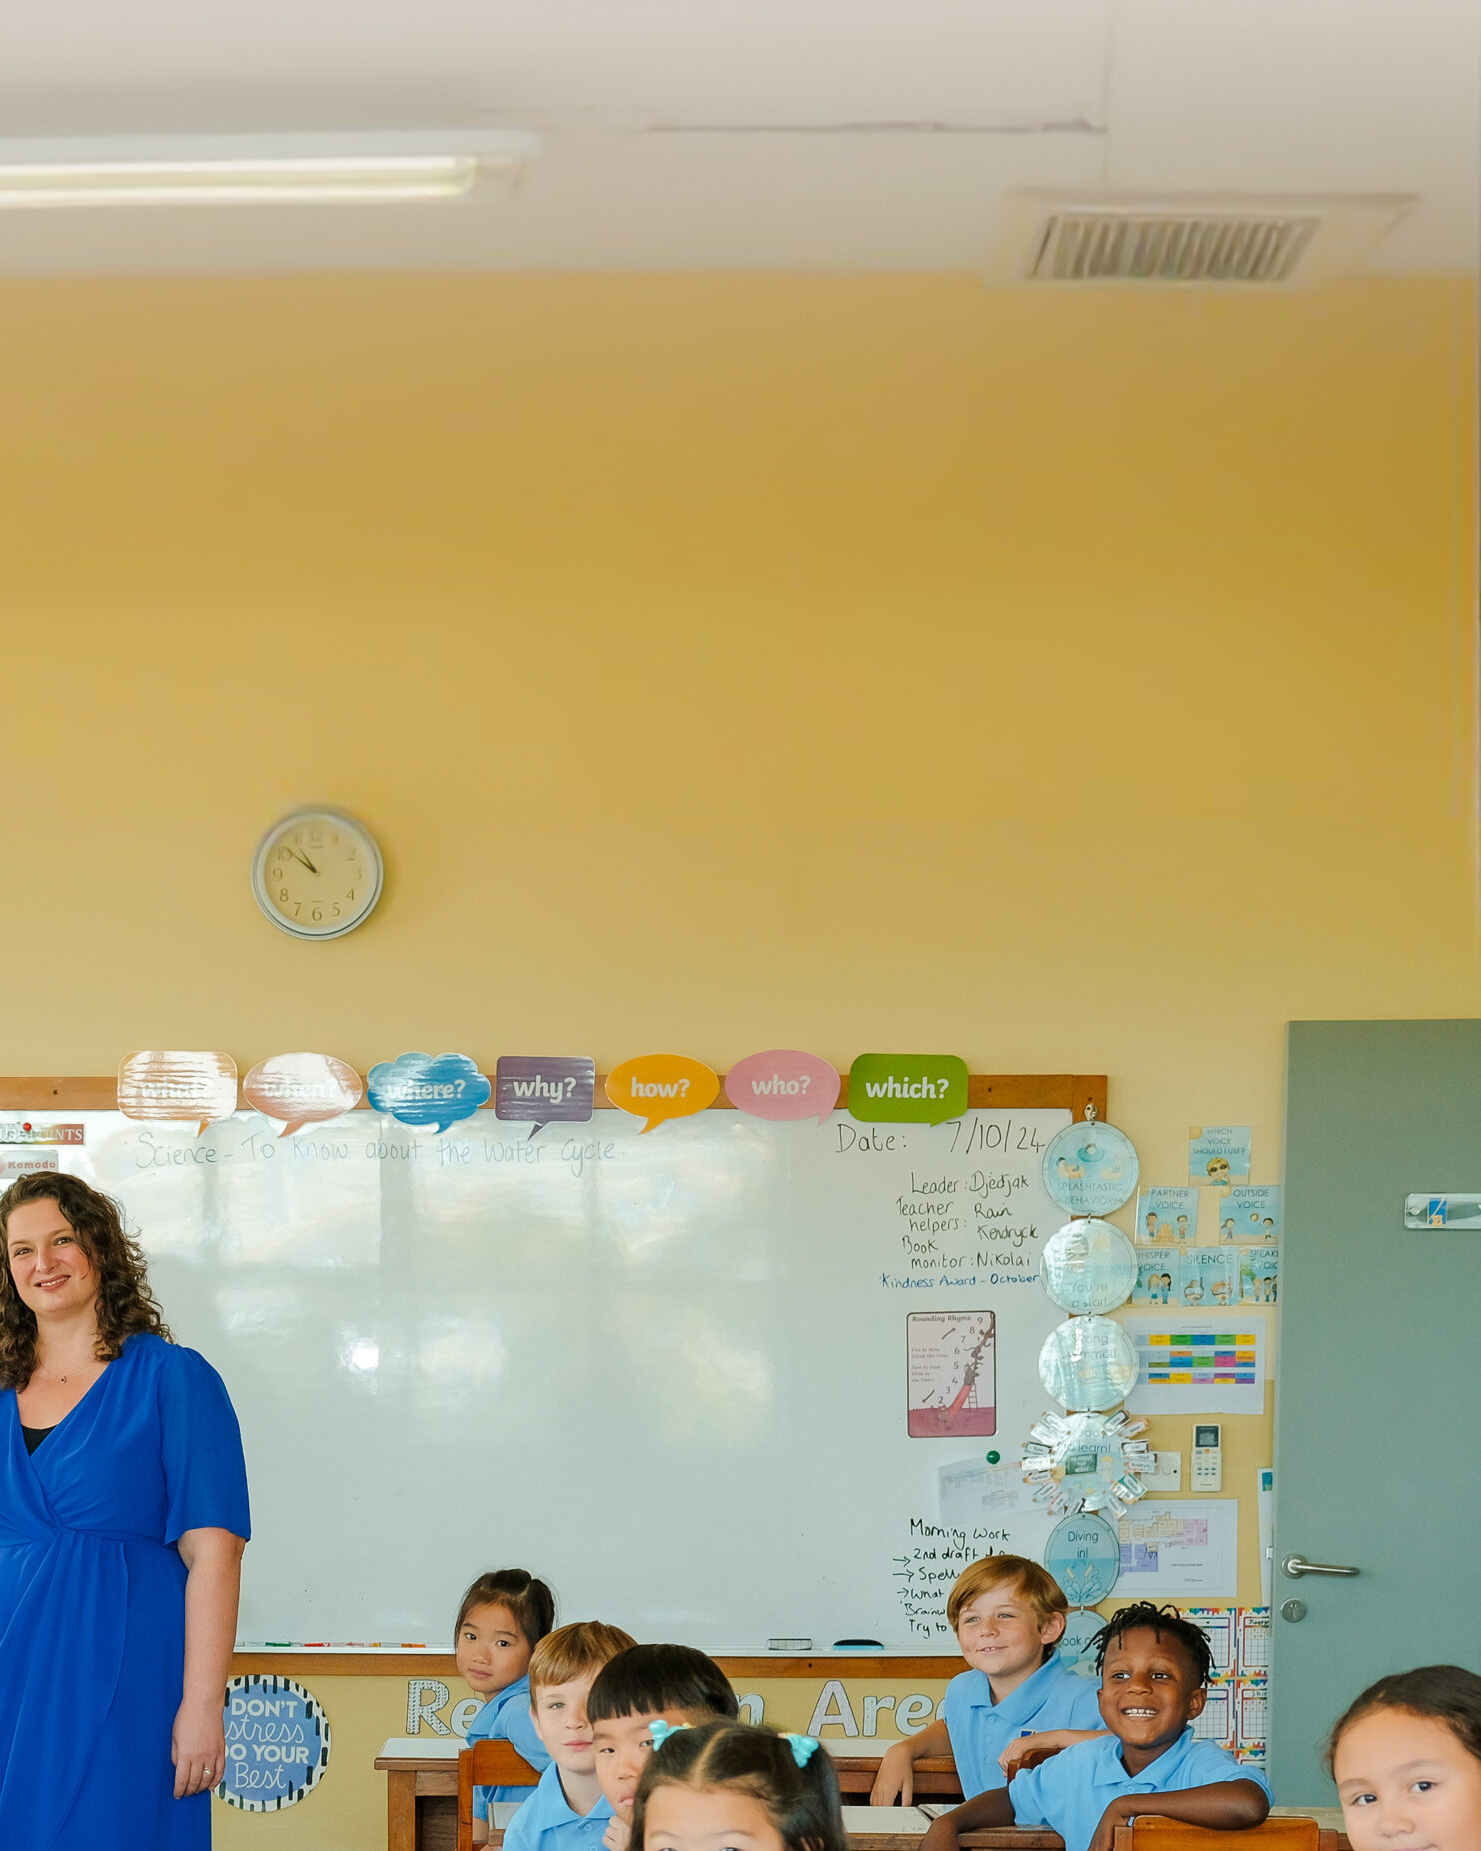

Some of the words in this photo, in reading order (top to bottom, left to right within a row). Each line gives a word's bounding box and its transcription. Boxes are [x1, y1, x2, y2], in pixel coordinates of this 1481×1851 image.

[280, 888, 289, 902] 8
[346, 888, 355, 901] 4
[294, 902, 302, 917] 7
[312, 907, 322, 921] 6
[332, 902, 340, 917] 5
[388, 1079, 466, 1100] where?
[513, 1075, 577, 1103] why?
[631, 1077, 690, 1098] how?
[752, 1074, 811, 1095] who?
[865, 1076, 949, 1099] which?
[946, 1117, 1046, 1155] 7/10/24
[1206, 1127, 1232, 1135] WHICH
[136, 1131, 217, 1169] Science
[241, 1130, 276, 1161] To
[366, 1138, 423, 1160] about
[436, 1139, 470, 1166] the
[8, 1160, 56, 1169] Komodo
[1056, 1182, 1123, 1193] SPLASHTASTIC
[1150, 1188, 1190, 1198] PARTNER
[1233, 1188, 1269, 1198] OUTSIDE
[896, 1196, 955, 1216] Teacher
[974, 1203, 1013, 1219] Rain
[1156, 1201, 1184, 1210] VOICE
[1237, 1200, 1266, 1209] VOICE
[1186, 1253, 1232, 1265] SILENCE
[939, 1275, 976, 1287] Award
[990, 1272, 1041, 1285] October
[912, 1315, 945, 1323] Rounding
[947, 1315, 972, 1323] Rhyme
[977, 1317, 983, 1325] 9
[969, 1326, 975, 1335] 8
[960, 1335, 966, 1343] 7
[954, 1346, 960, 1355] 6
[938, 1396, 944, 1404] 2
[1079, 1444, 1111, 1454] learn!
[910, 1518, 966, 1551] Morning
[1067, 1531, 1099, 1543] Diving
[913, 1547, 937, 1560] 2nd
[941, 1546, 979, 1562] draft
[1077, 1547, 1088, 1558] in!
[908, 1619, 931, 1639] Try
[936, 1622, 948, 1632] to
[1062, 1635, 1081, 1646] ook
[230, 1698, 298, 1719] DON'T
[224, 1713, 305, 1744] stress
[252, 1743, 310, 1765] YOUR
[233, 1762, 287, 1790] Best
